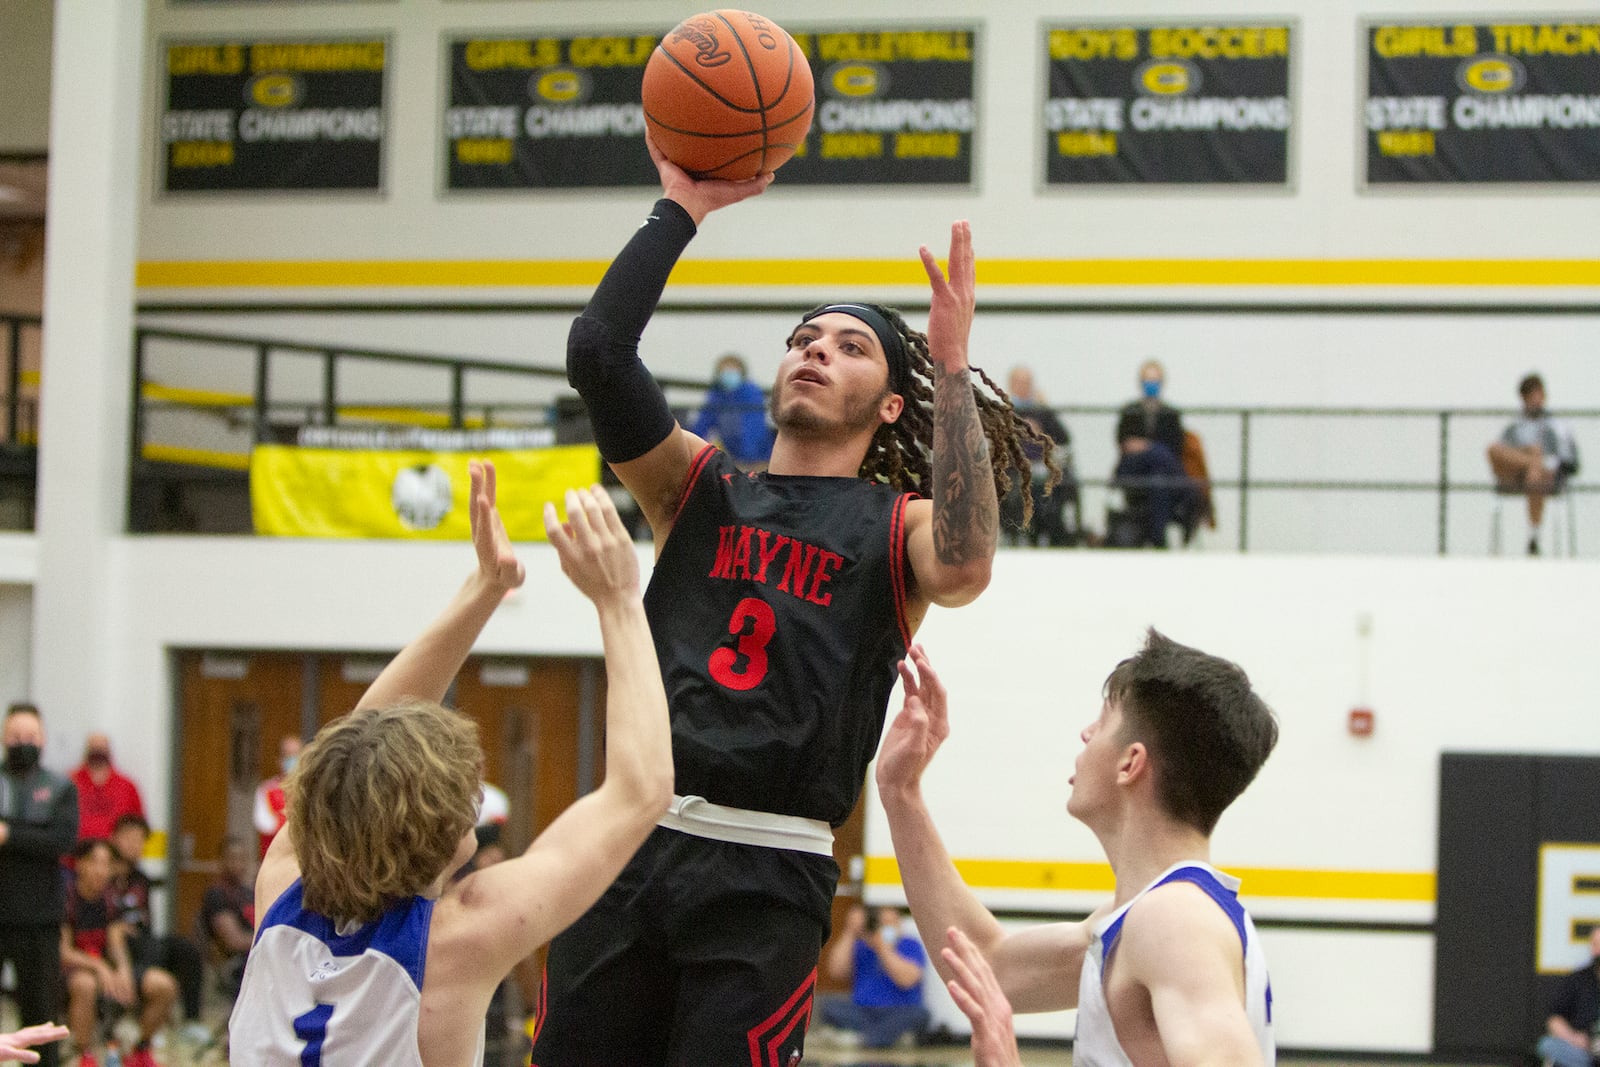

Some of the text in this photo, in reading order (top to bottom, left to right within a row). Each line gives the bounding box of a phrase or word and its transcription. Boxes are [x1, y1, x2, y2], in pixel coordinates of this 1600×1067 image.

[465, 36, 657, 70] GIRLS GOLF
[818, 31, 971, 61] VOLLEYBALL
[1048, 27, 1288, 60] BOYS SOCCER
[1375, 26, 1478, 58] GIRLS
[163, 107, 379, 143] STATE CHAMPIONS
[447, 103, 647, 139] STATE CHAMPIO
[819, 100, 972, 132] CHAMPIONS
[1045, 97, 1291, 131] STATE CHAMPIONS
[1366, 96, 1447, 130] STATE
[708, 524, 845, 608] WAYNE
[707, 597, 777, 691] 3
